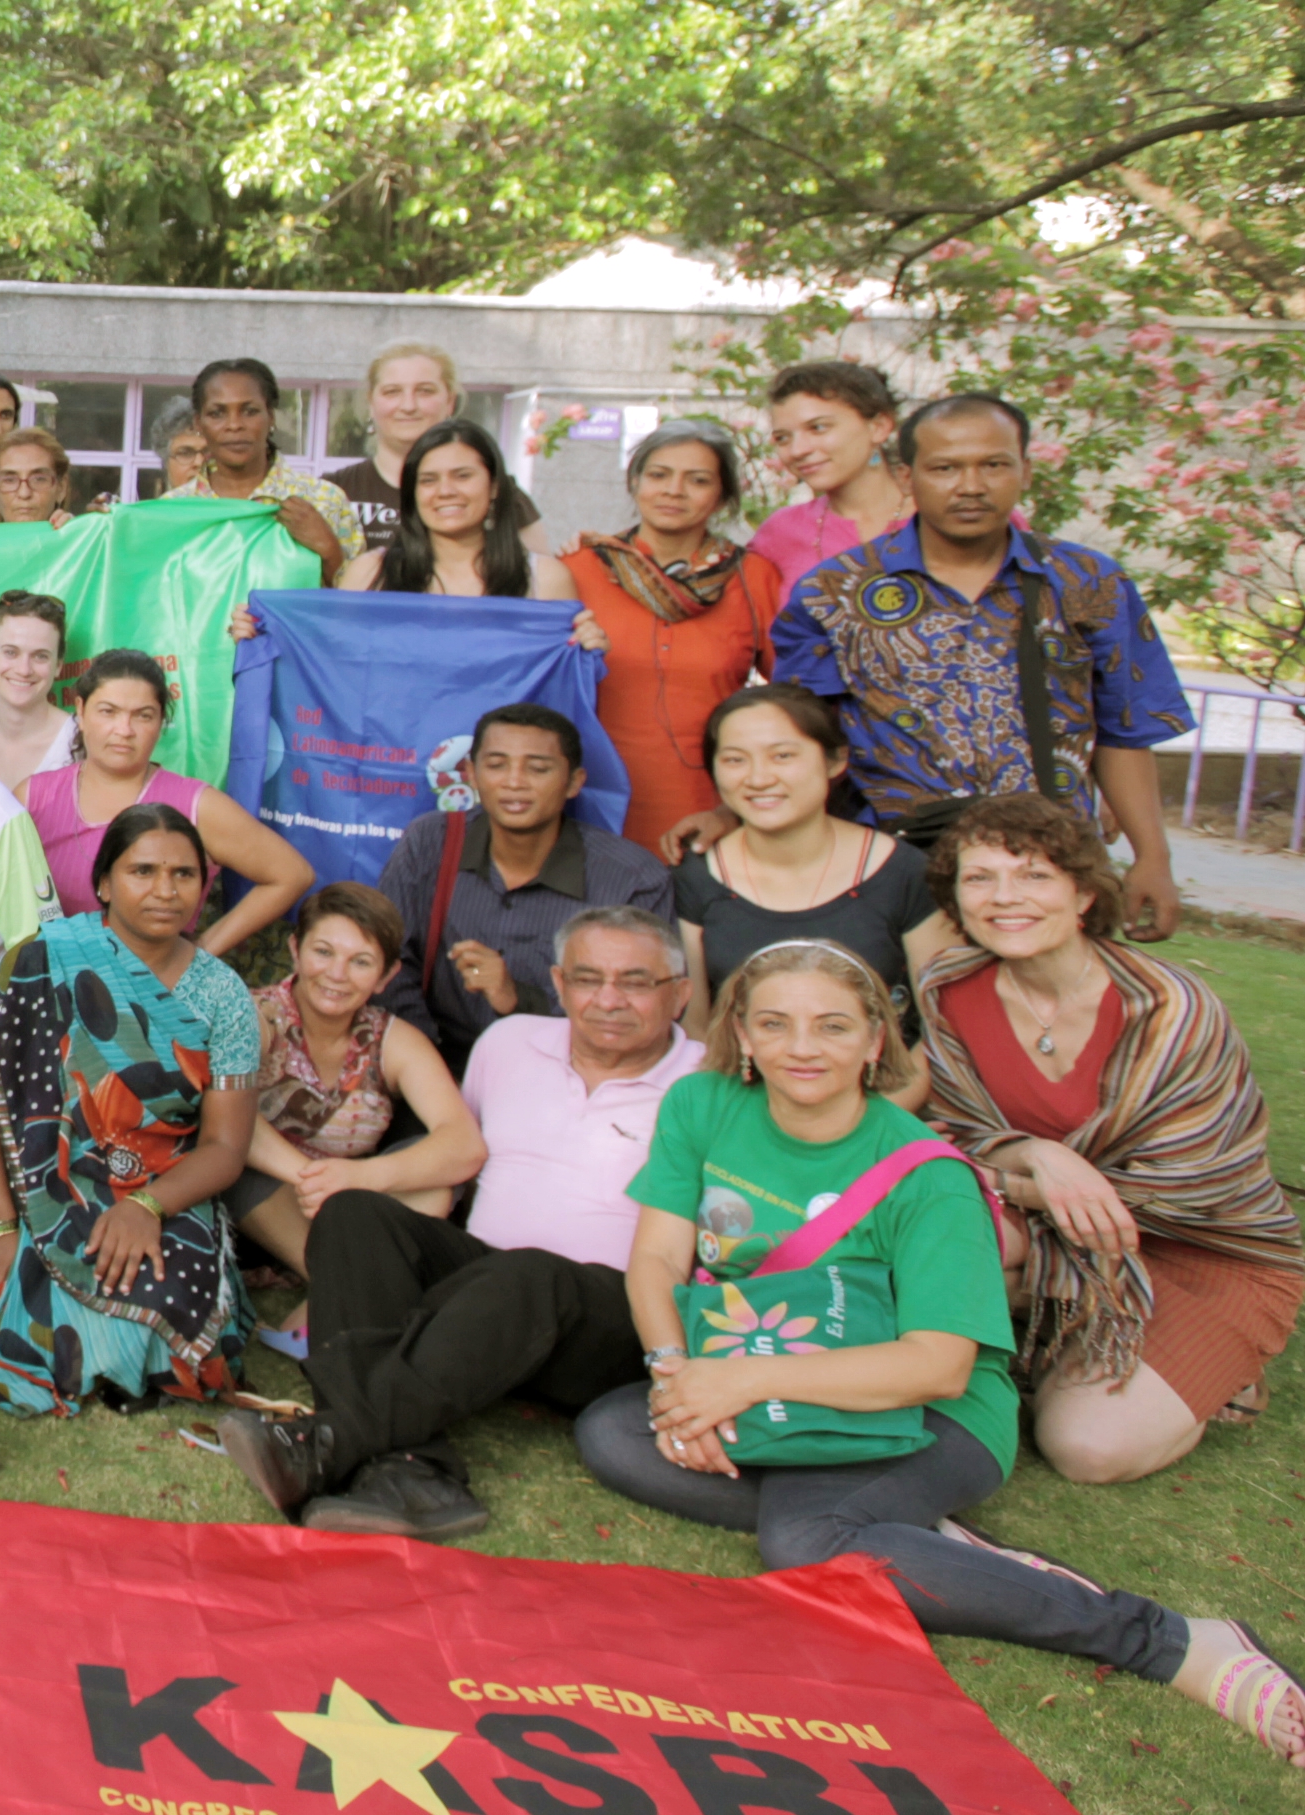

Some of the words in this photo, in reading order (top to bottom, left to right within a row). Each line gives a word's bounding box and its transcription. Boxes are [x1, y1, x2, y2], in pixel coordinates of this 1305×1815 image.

[296, 705, 322, 726] Red
[292, 732, 417, 764] Latinoamericana
[292, 768, 310, 786] de
[322, 770, 417, 797] Recicladores
[274, 809, 293, 827] hay
[295, 812, 342, 833] fronteras
[368, 821, 385, 838] los
[387, 827, 404, 840] qu
[825, 1322, 844, 1339] Es
[449, 1677, 892, 1751] CONFEDERATION
